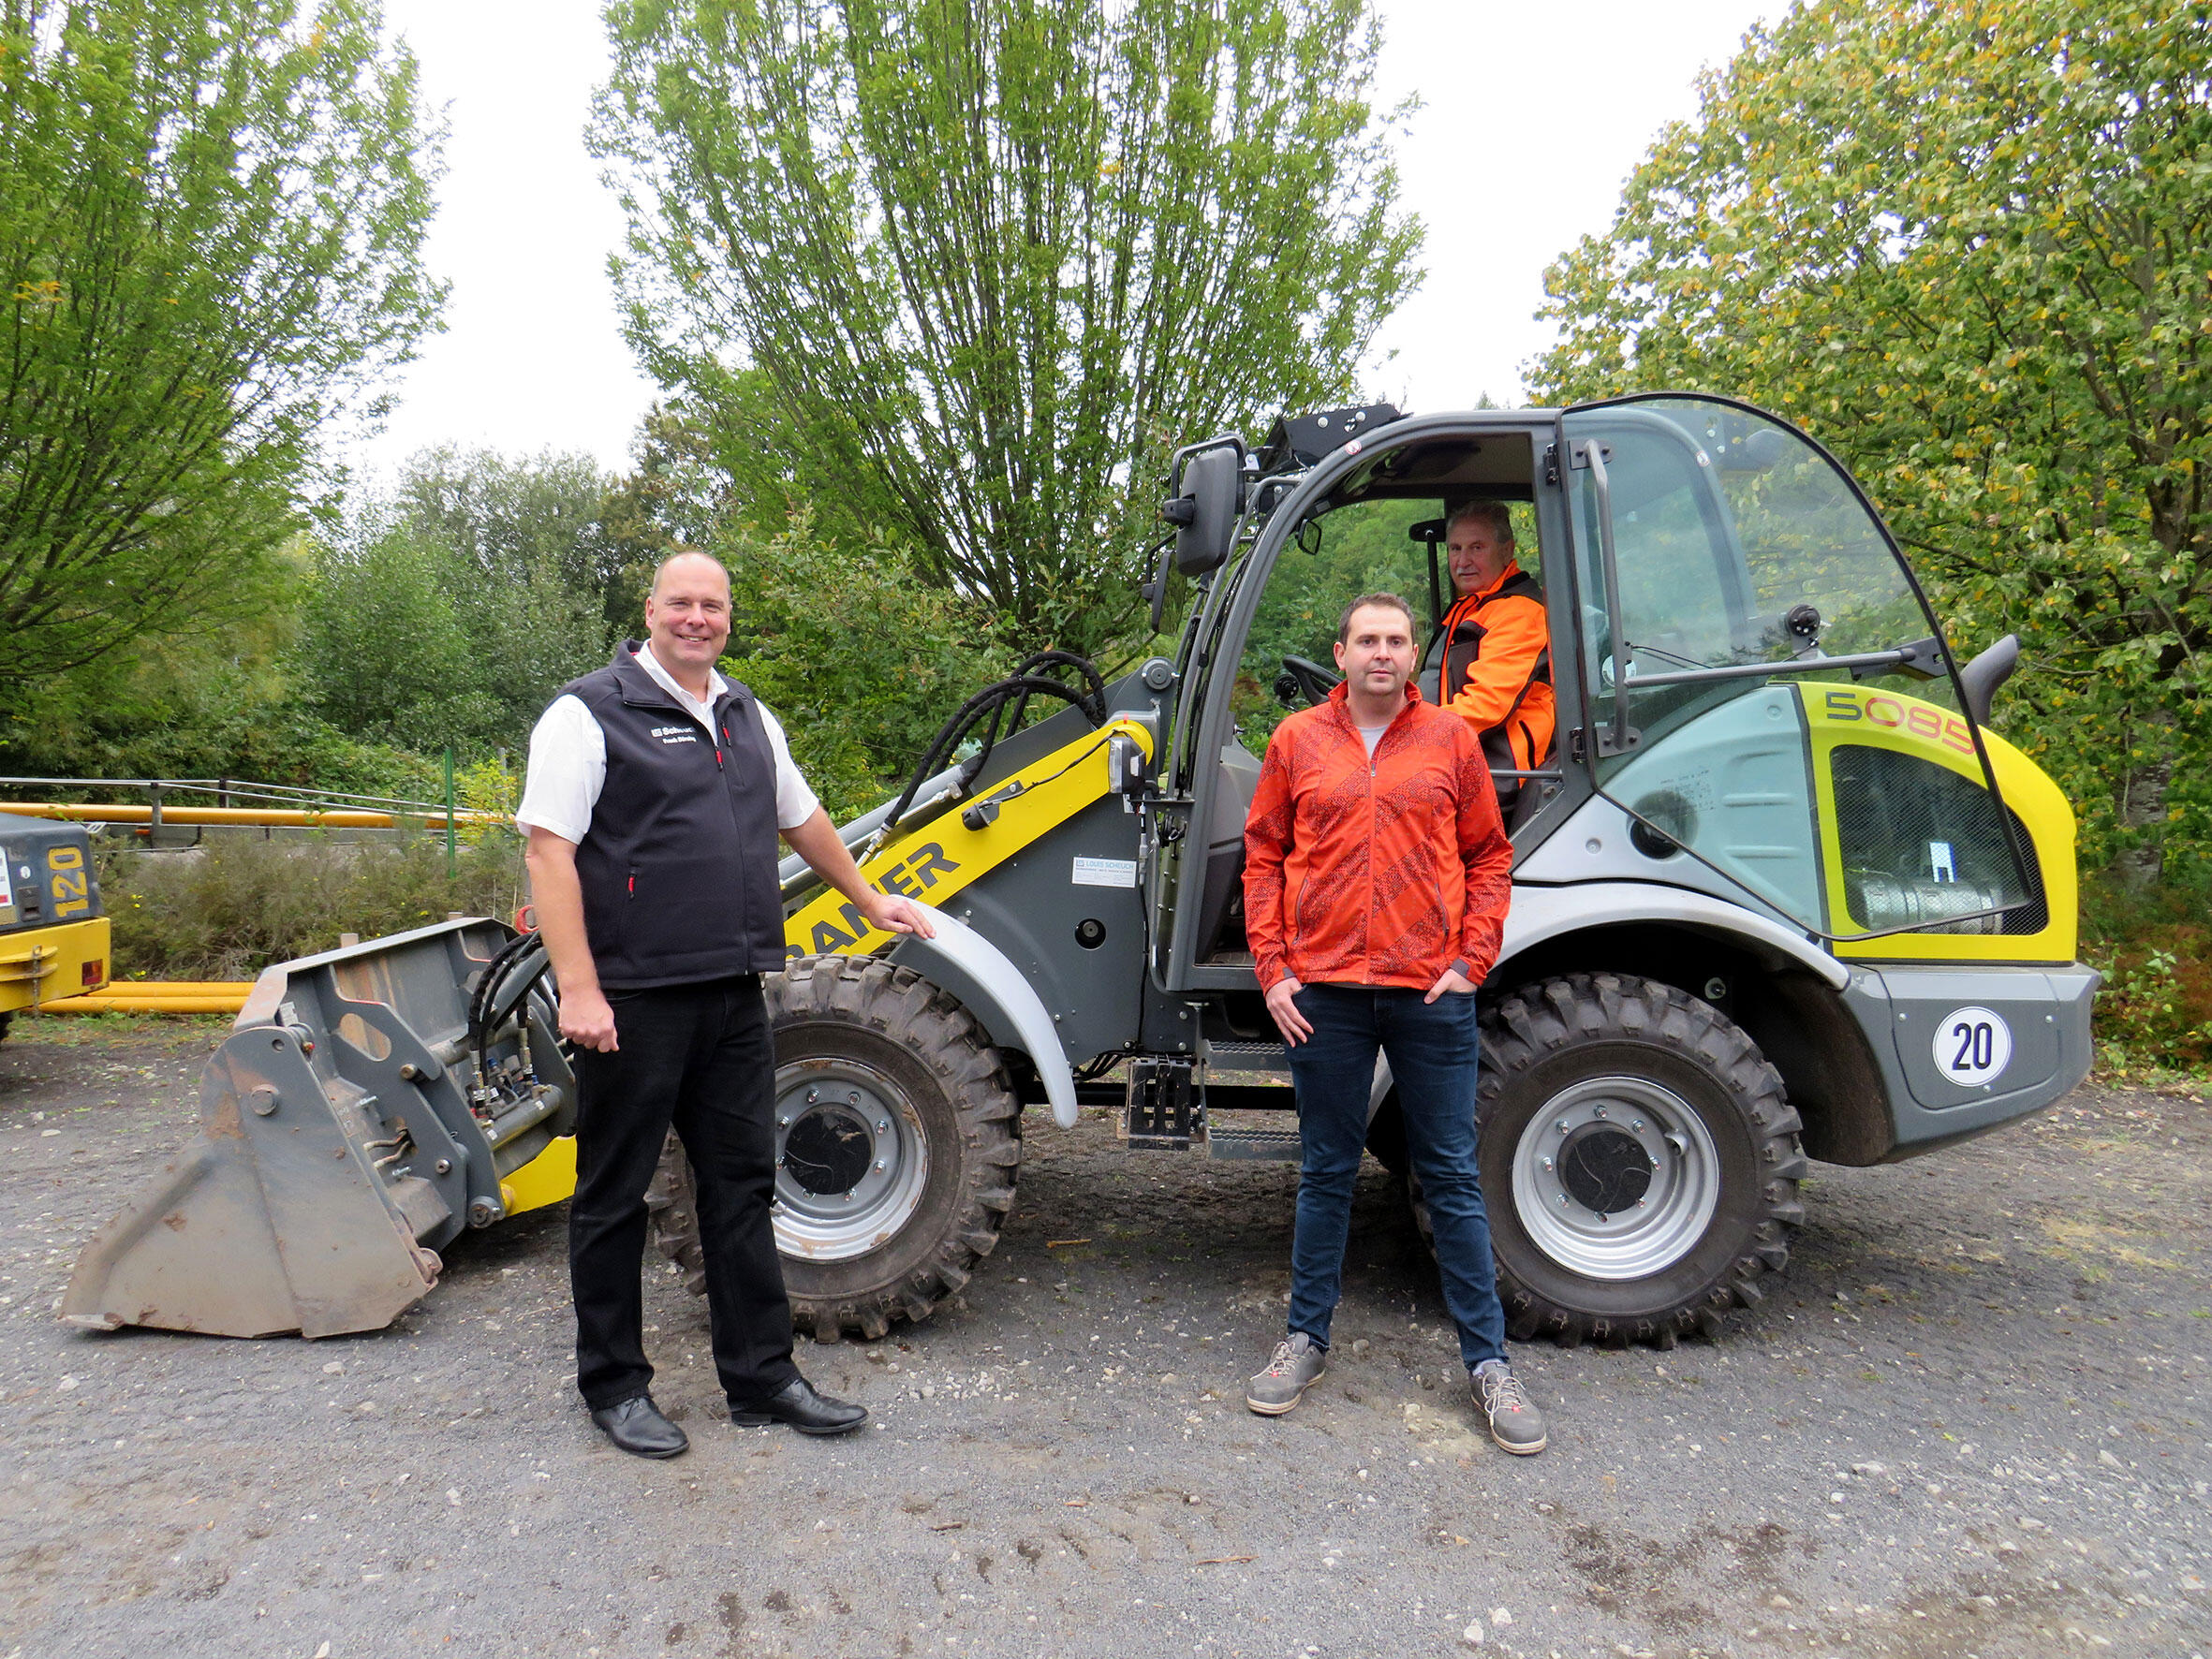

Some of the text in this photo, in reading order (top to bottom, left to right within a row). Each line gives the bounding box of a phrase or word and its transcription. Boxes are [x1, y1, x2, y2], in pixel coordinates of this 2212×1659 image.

[1825, 691, 1976, 756] 5085
[48, 846, 89, 918] 120
[1953, 1021, 1993, 1070] 20
